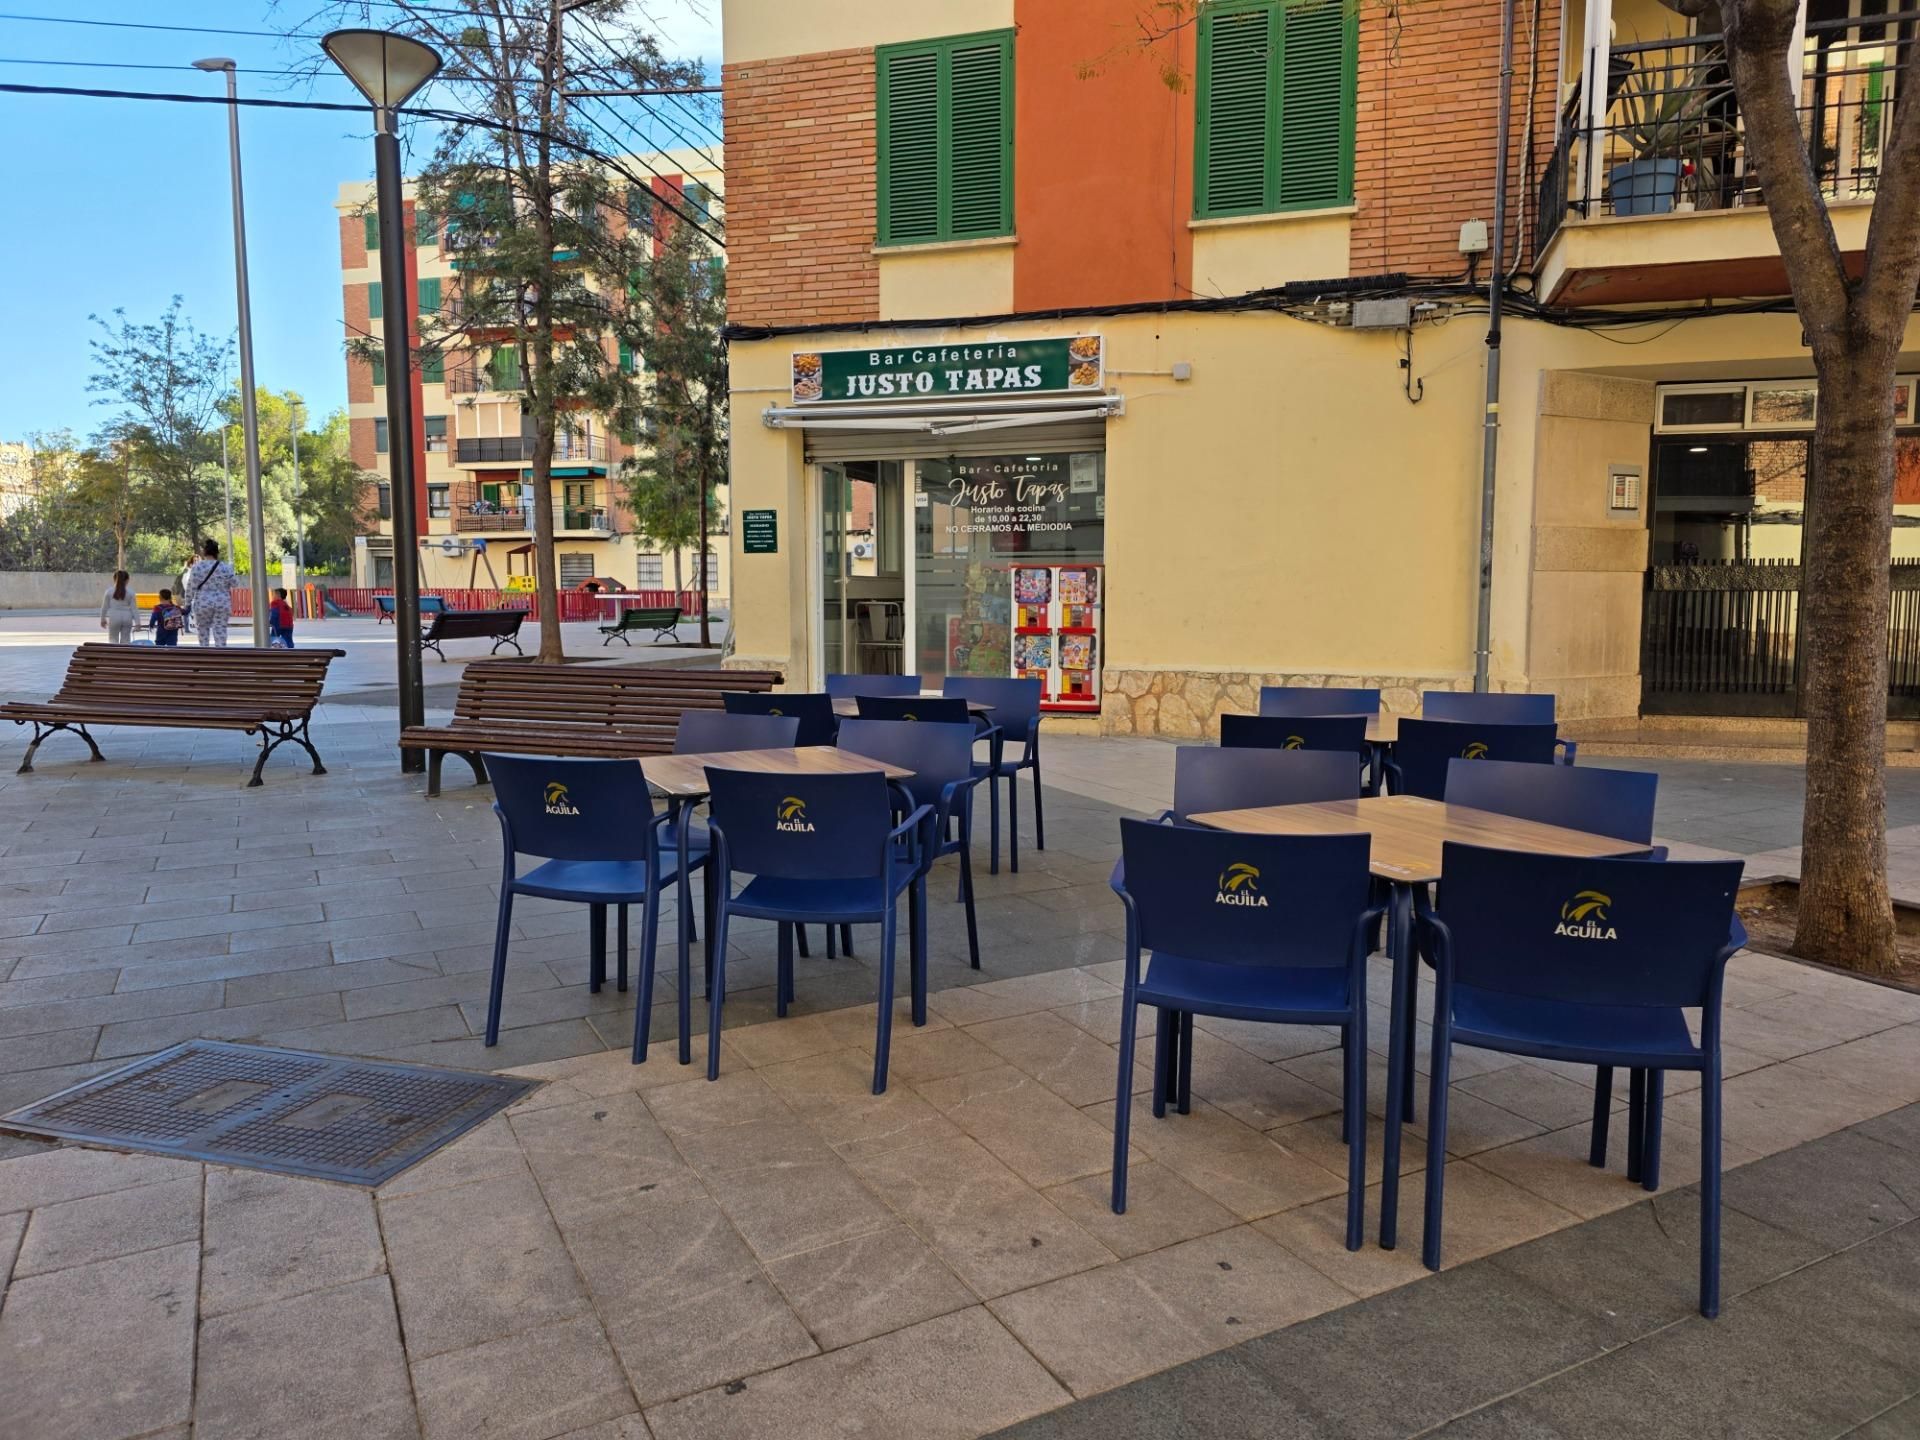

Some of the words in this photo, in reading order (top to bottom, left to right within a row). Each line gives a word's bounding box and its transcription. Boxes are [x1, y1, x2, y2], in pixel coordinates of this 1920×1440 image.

[869, 352, 905, 366] Bar
[846, 371, 935, 397] JUSTO
[945, 365, 1043, 391] TAPAS
[959, 465, 982, 475] Bar
[948, 477, 1007, 507] Justo
[1012, 474, 1070, 505] Tapas
[970, 505, 1001, 514] Horario
[1004, 505, 1015, 513] de
[1017, 504, 1046, 512] cocina
[974, 515, 986, 523] de
[987, 514, 1010, 524] 10,00
[1019, 513, 1042, 523] 22,30
[945, 525, 959, 533] NO
[960, 524, 1012, 533] CERRAMOS
[1013, 523, 1026, 531] AL
[1027, 522, 1073, 531] MEDIODIA
